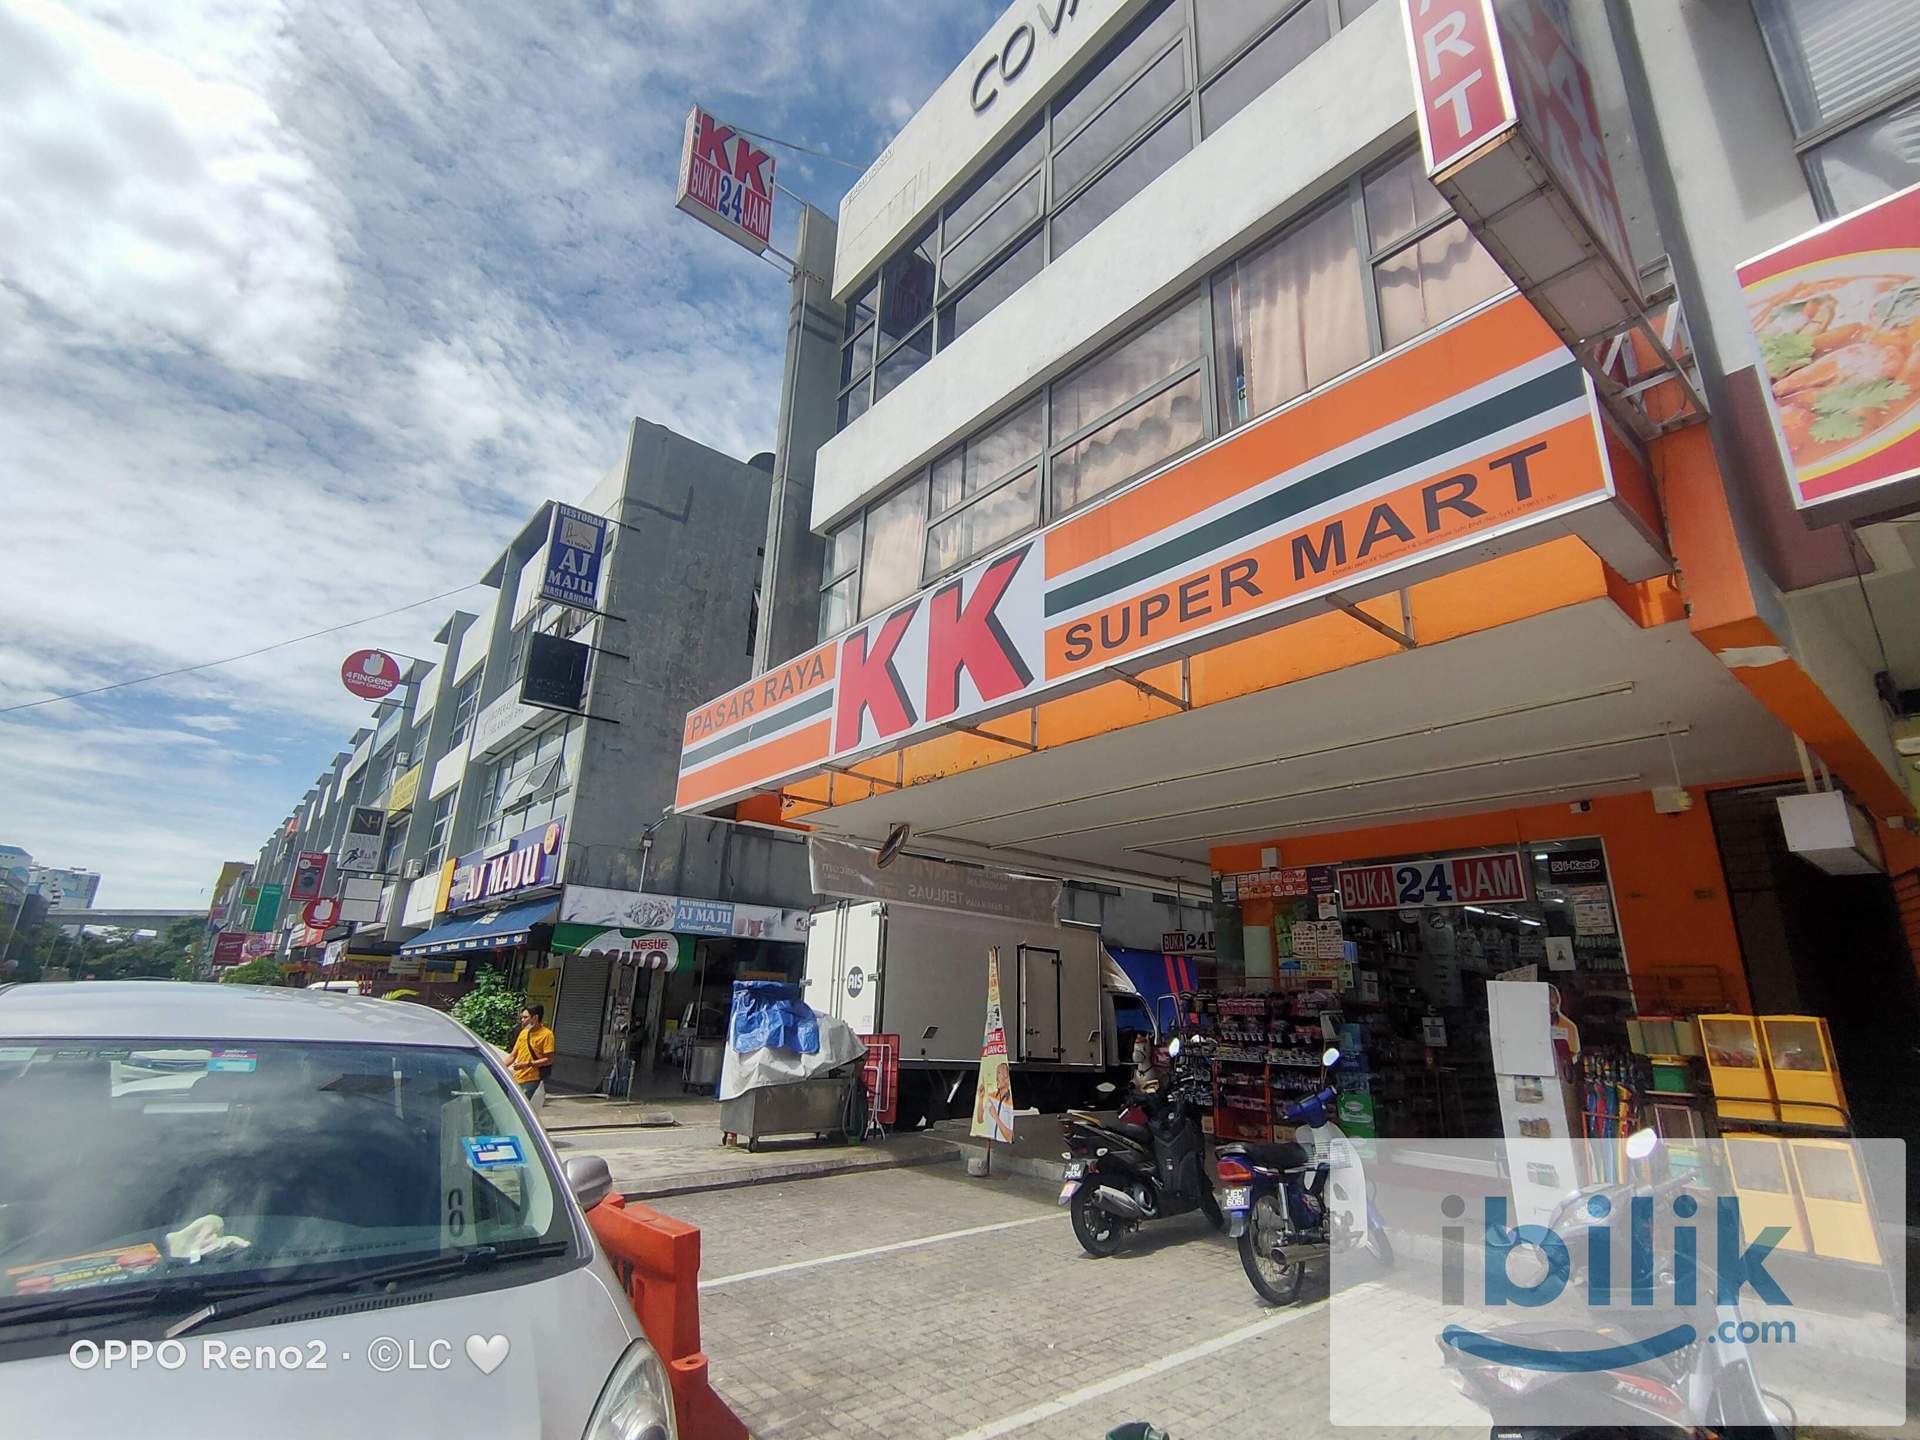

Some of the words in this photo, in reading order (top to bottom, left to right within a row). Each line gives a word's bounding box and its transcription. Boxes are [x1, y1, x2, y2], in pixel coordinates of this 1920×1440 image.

[970, 0, 1080, 112] COV
[1419, 0, 1482, 138] RT
[700, 112, 770, 197] KK
[691, 157, 719, 209] BUKA
[719, 175, 743, 224] 24
[743, 188, 769, 242] JAM
[560, 505, 605, 529] RESTORAN
[1064, 558, 1263, 662] SUPER
[1290, 441, 1547, 580] MART
[547, 569, 594, 595] MAJU
[558, 547, 592, 577] AJ
[834, 540, 1036, 755] KK
[689, 687, 756, 741] PASAR
[763, 653, 826, 700] RAYA
[462, 863, 487, 903] AJ
[485, 842, 540, 897] MAJU
[1343, 870, 1393, 907] BUKA
[1397, 863, 1453, 904] 24
[1459, 859, 1519, 898] JAM
[677, 905, 694, 920] AJ
[695, 908, 732, 924] MAJU
[1164, 935, 1185, 950] BUKA
[1186, 932, 1208, 950] 24
